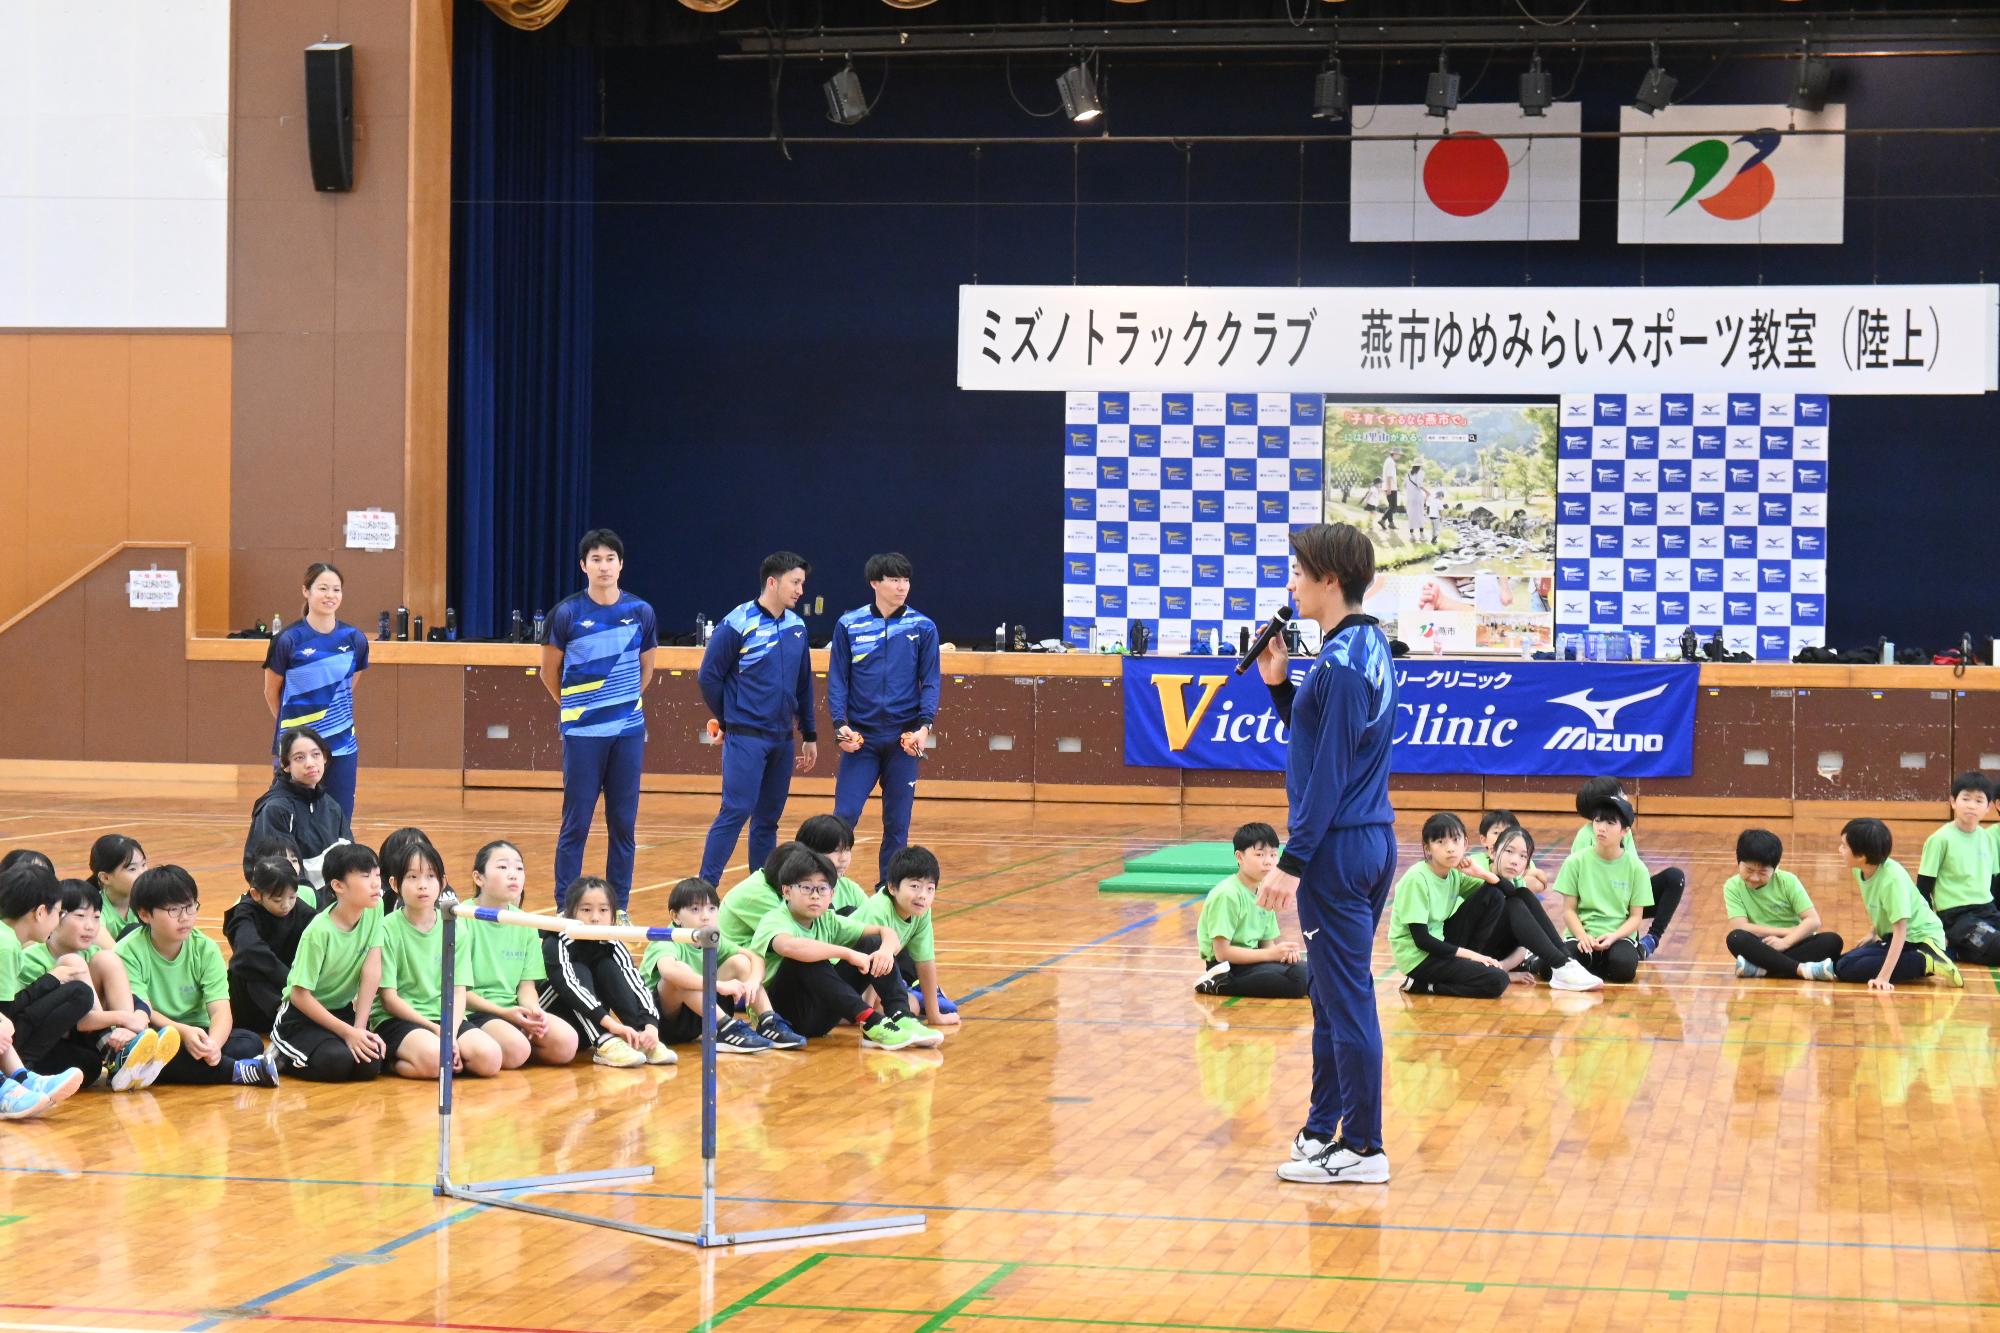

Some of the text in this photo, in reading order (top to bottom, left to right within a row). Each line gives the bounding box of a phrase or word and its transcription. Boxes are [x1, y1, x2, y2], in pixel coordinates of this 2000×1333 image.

[982, 306, 1318, 367] ミズノトラッククラブ
[1151, 674, 1291, 752] Vict
[1543, 726, 1664, 752] MIZUNO
